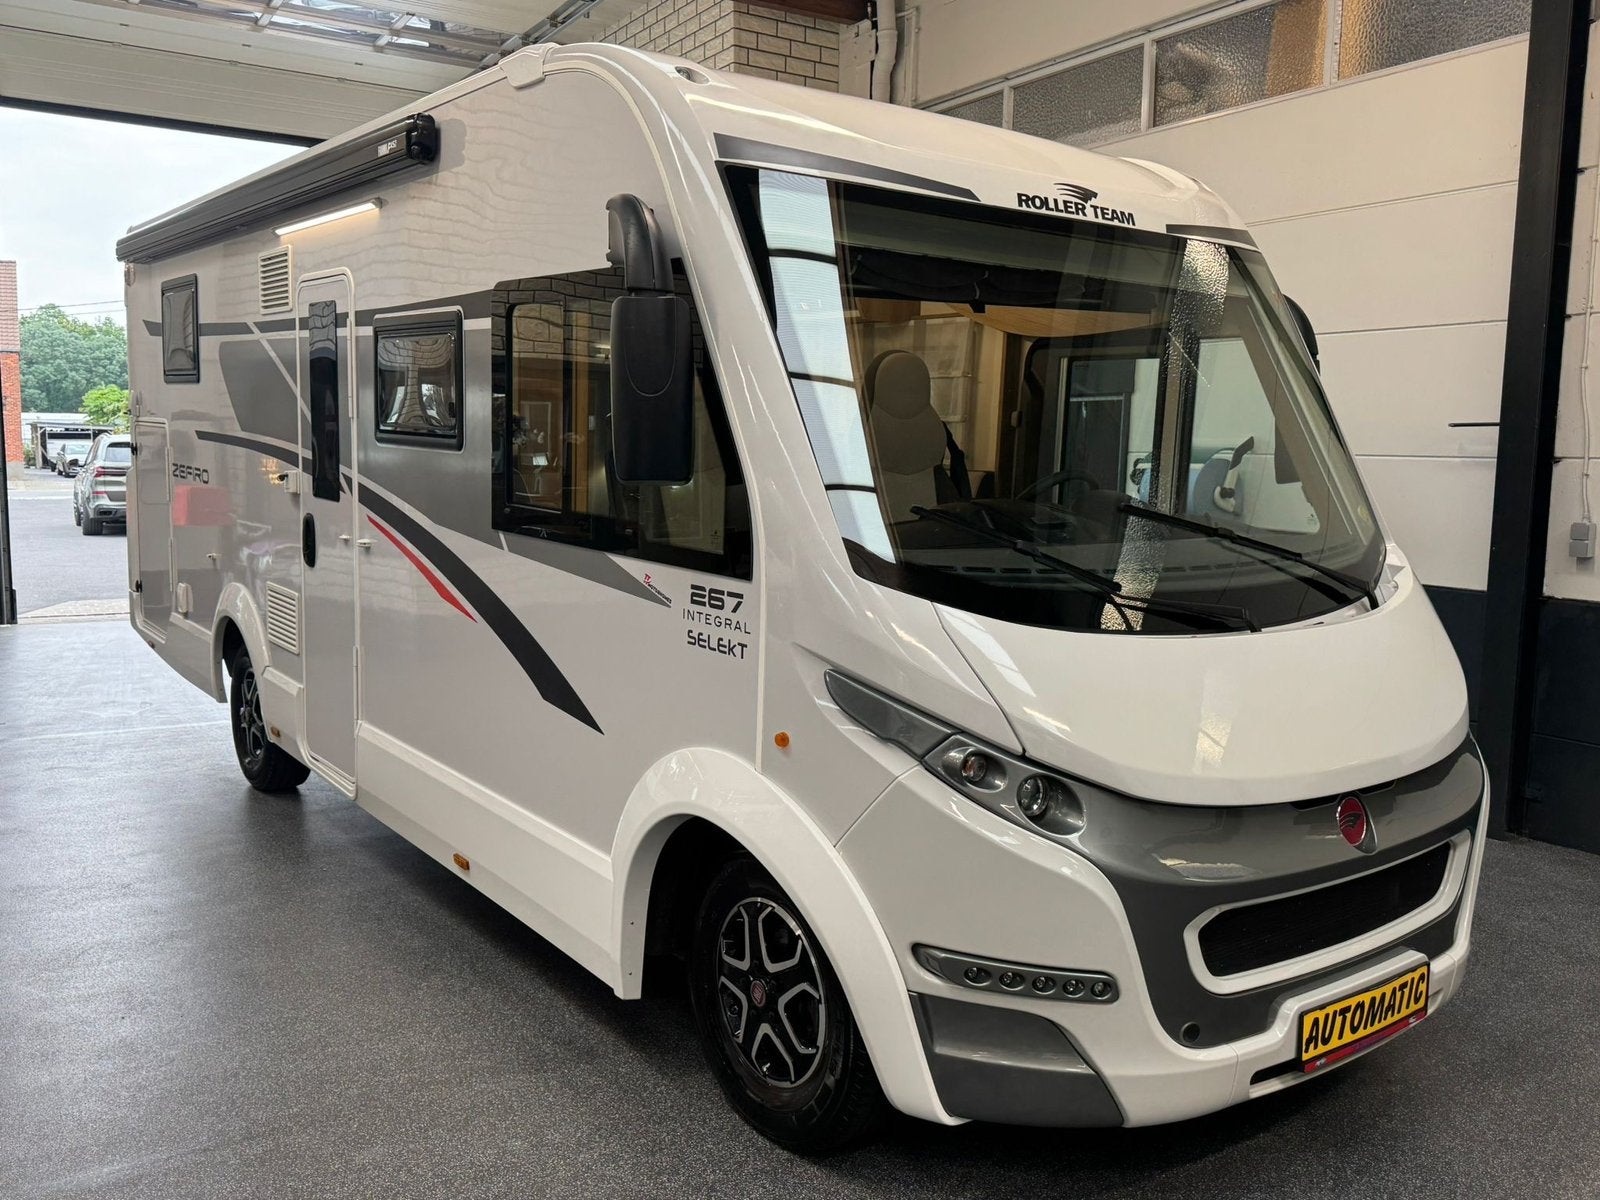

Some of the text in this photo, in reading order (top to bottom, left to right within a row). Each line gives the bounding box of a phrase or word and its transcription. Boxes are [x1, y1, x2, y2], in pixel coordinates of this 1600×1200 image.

[1017, 192, 1136, 226] ROLLER TEAM
[690, 583, 744, 613] 267
[682, 607, 751, 635] INTEGRAL
[687, 628, 748, 660] SELEKT
[1304, 972, 1426, 1054] AUTOMATIC
